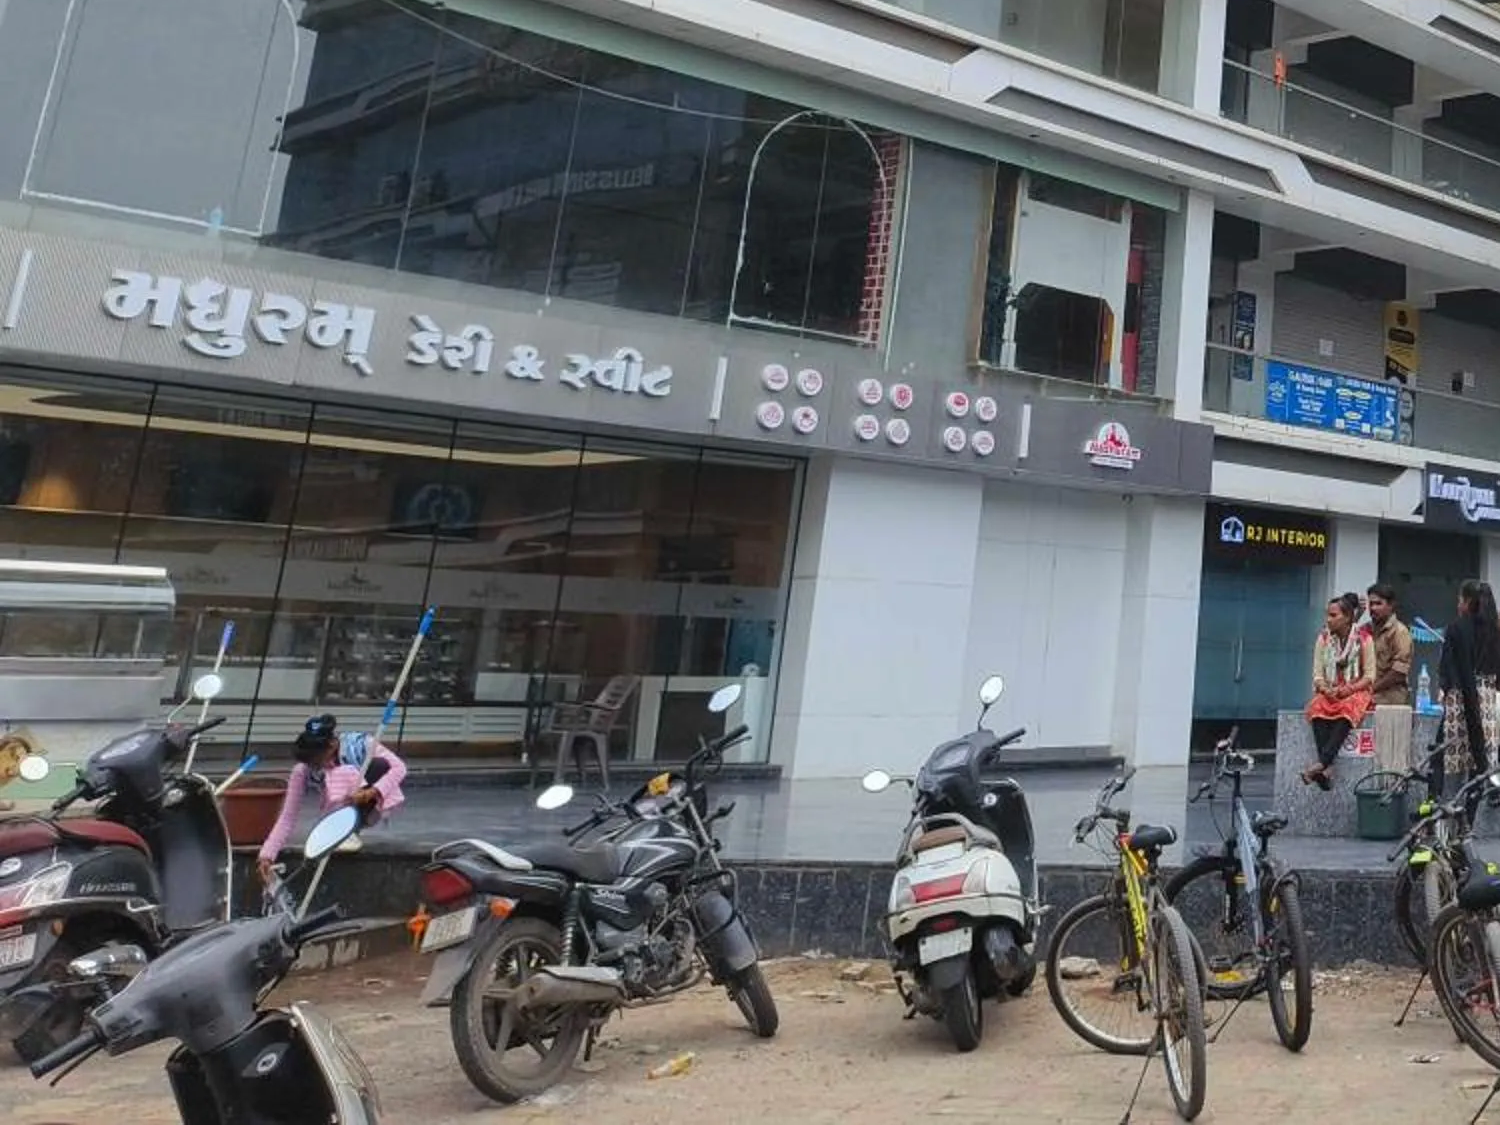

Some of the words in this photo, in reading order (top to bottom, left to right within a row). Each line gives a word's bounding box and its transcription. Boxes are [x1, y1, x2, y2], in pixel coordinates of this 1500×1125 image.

[101, 267, 377, 376] મધુરમ્
[405, 313, 496, 375] ડેરી
[505, 343, 546, 383] &
[1266, 527, 1326, 549] INTERIOR
